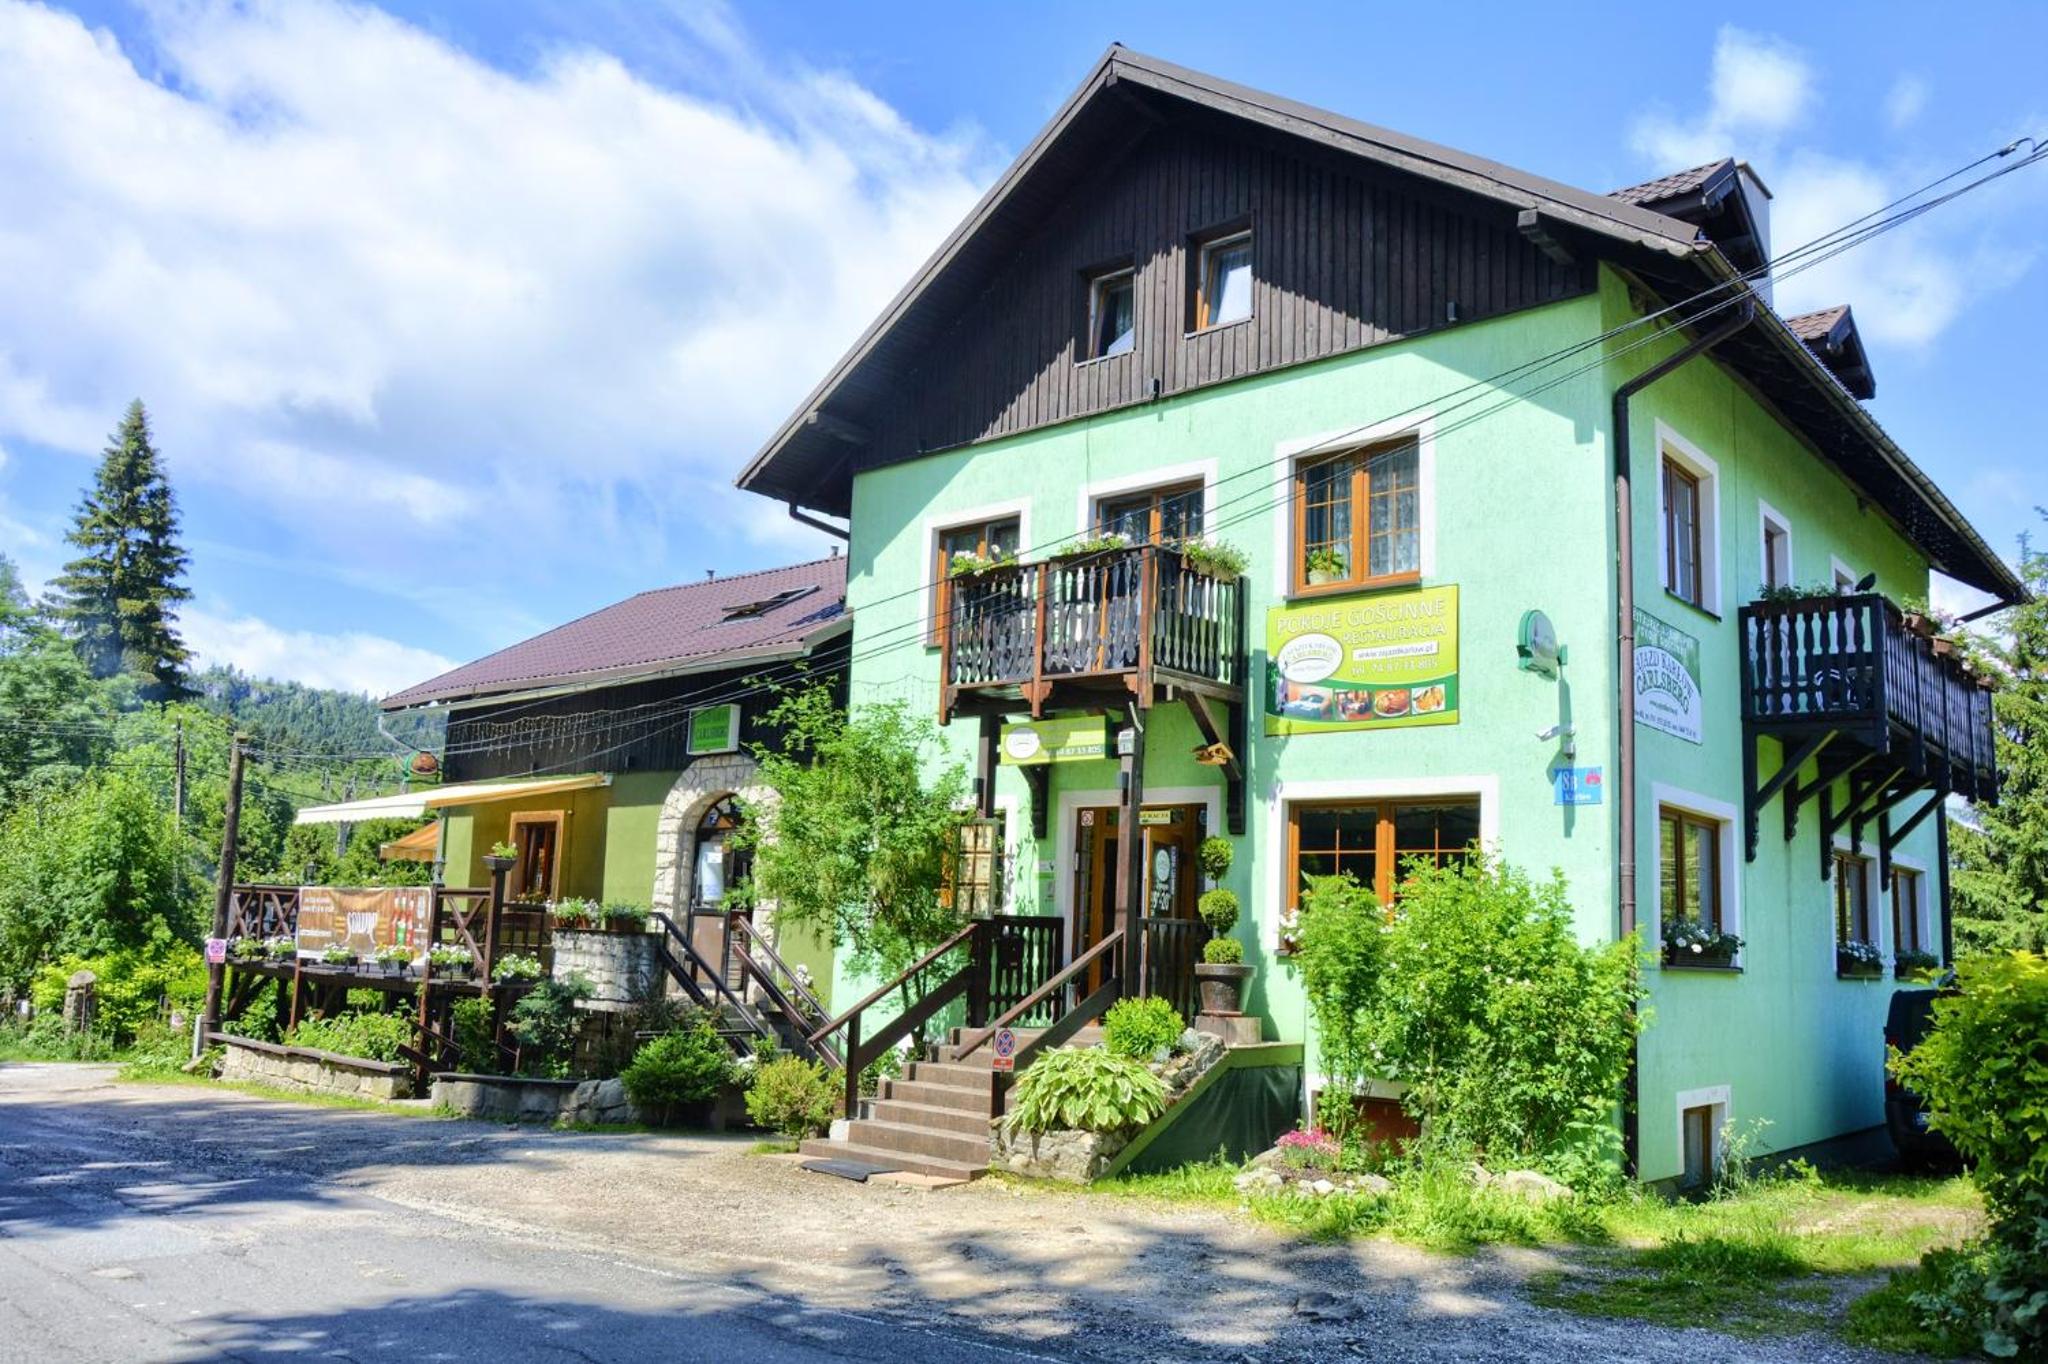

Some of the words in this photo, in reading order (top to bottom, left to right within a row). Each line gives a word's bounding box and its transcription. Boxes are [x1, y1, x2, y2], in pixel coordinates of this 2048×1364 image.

[1277, 611, 1344, 634] POKOJE
[1348, 599, 1446, 627] GOŚCINNE
[1342, 620, 1446, 645] RESTAURACJA
[1636, 668, 1690, 715] CARLSBERG
